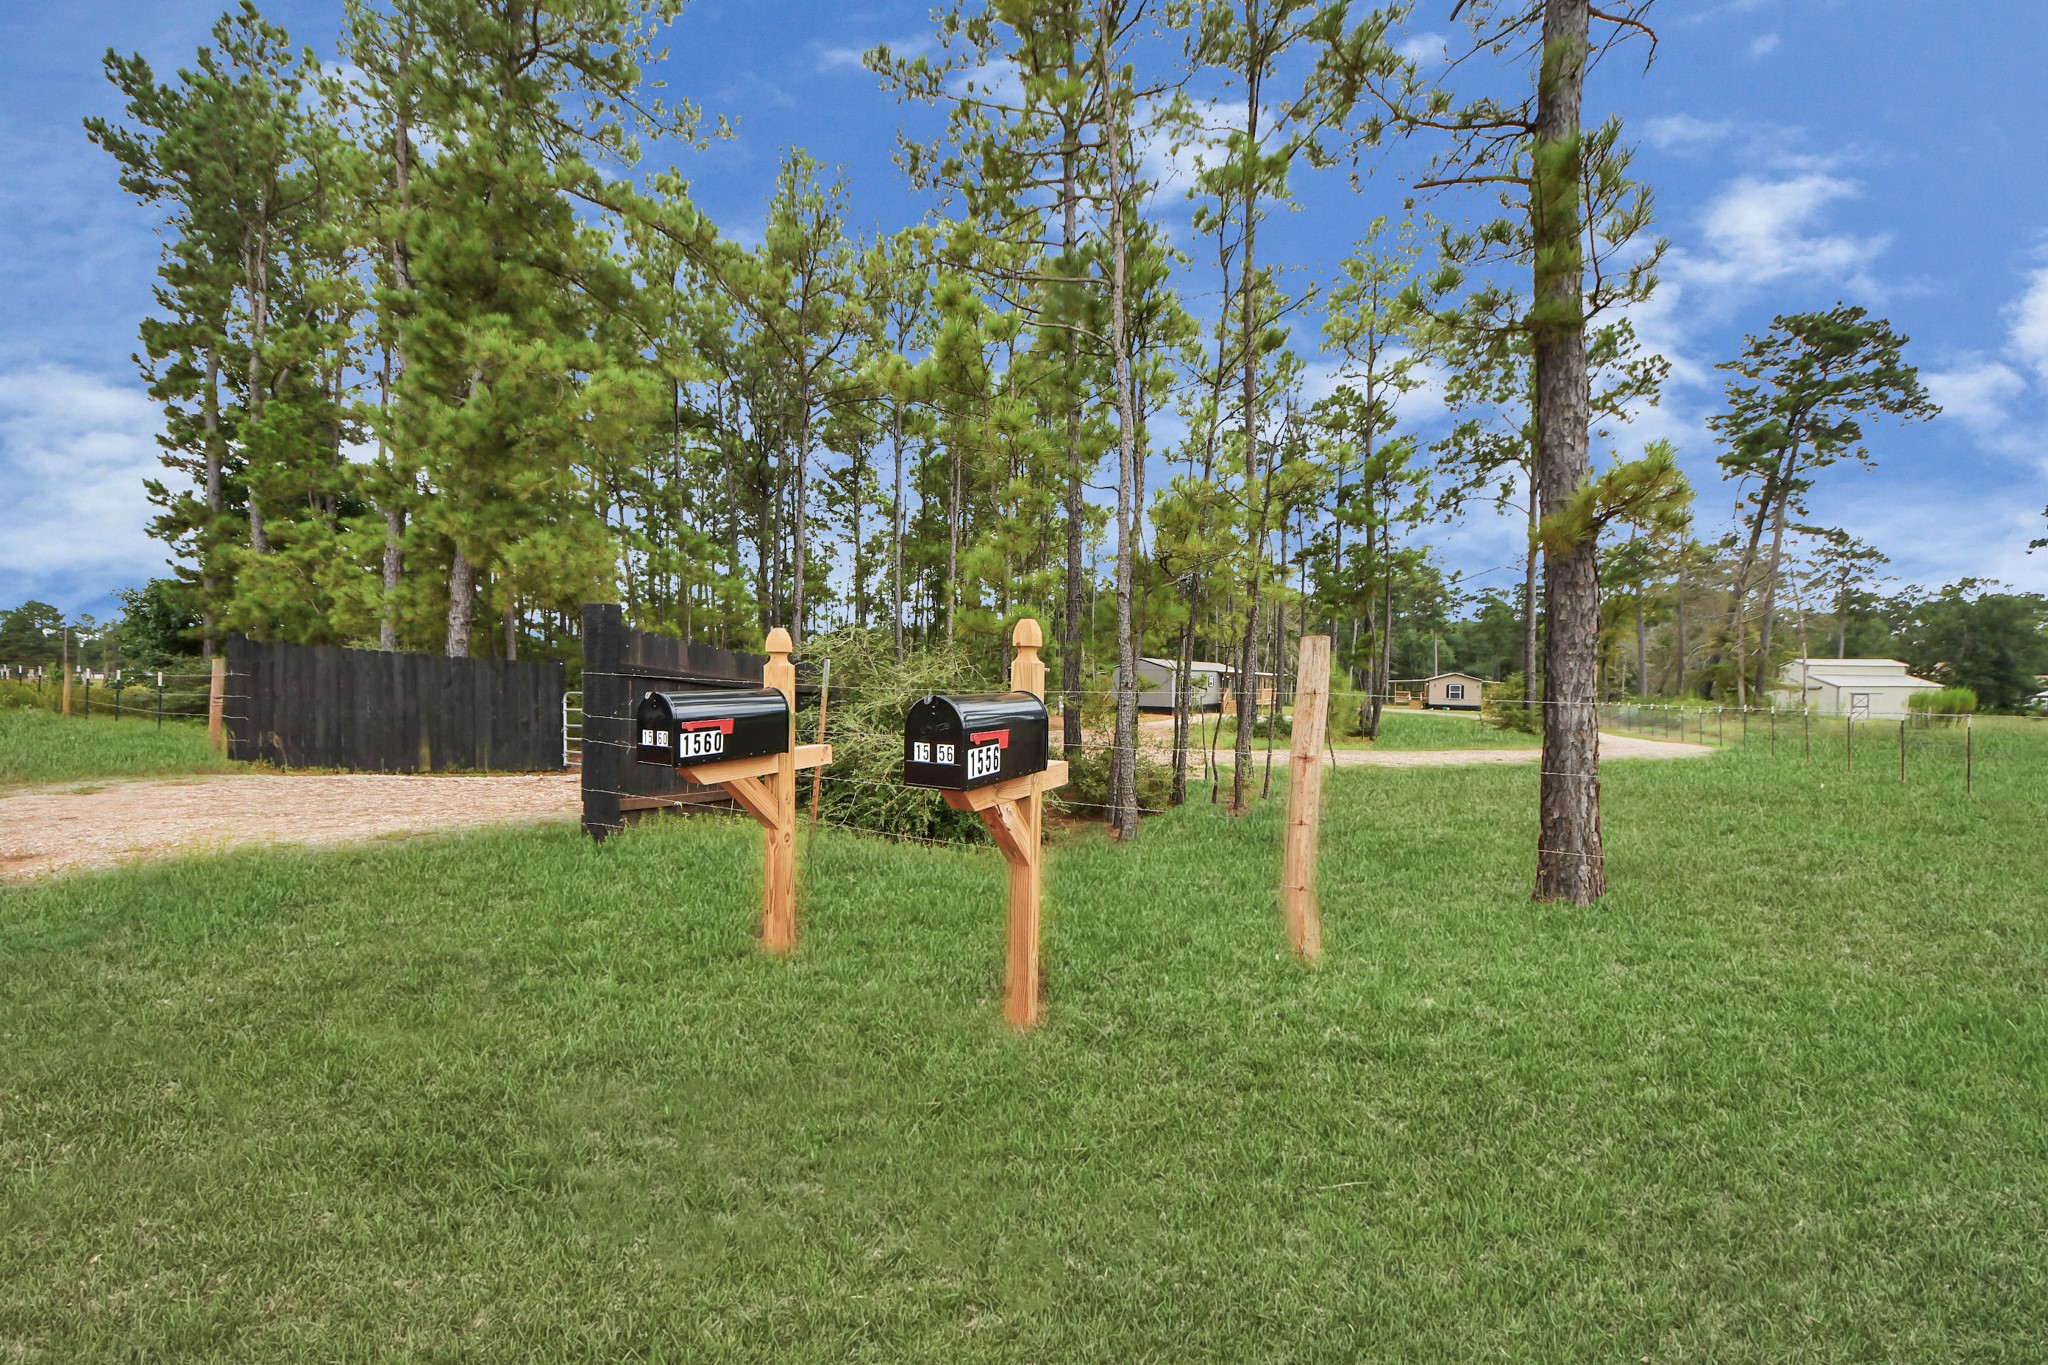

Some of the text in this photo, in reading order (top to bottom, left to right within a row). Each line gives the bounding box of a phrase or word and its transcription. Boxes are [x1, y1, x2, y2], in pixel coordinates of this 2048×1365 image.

[643, 731, 668, 745] 15 60
[684, 732, 722, 756] 1560
[916, 744, 953, 762] 15 56
[970, 745, 999, 777] 1556
